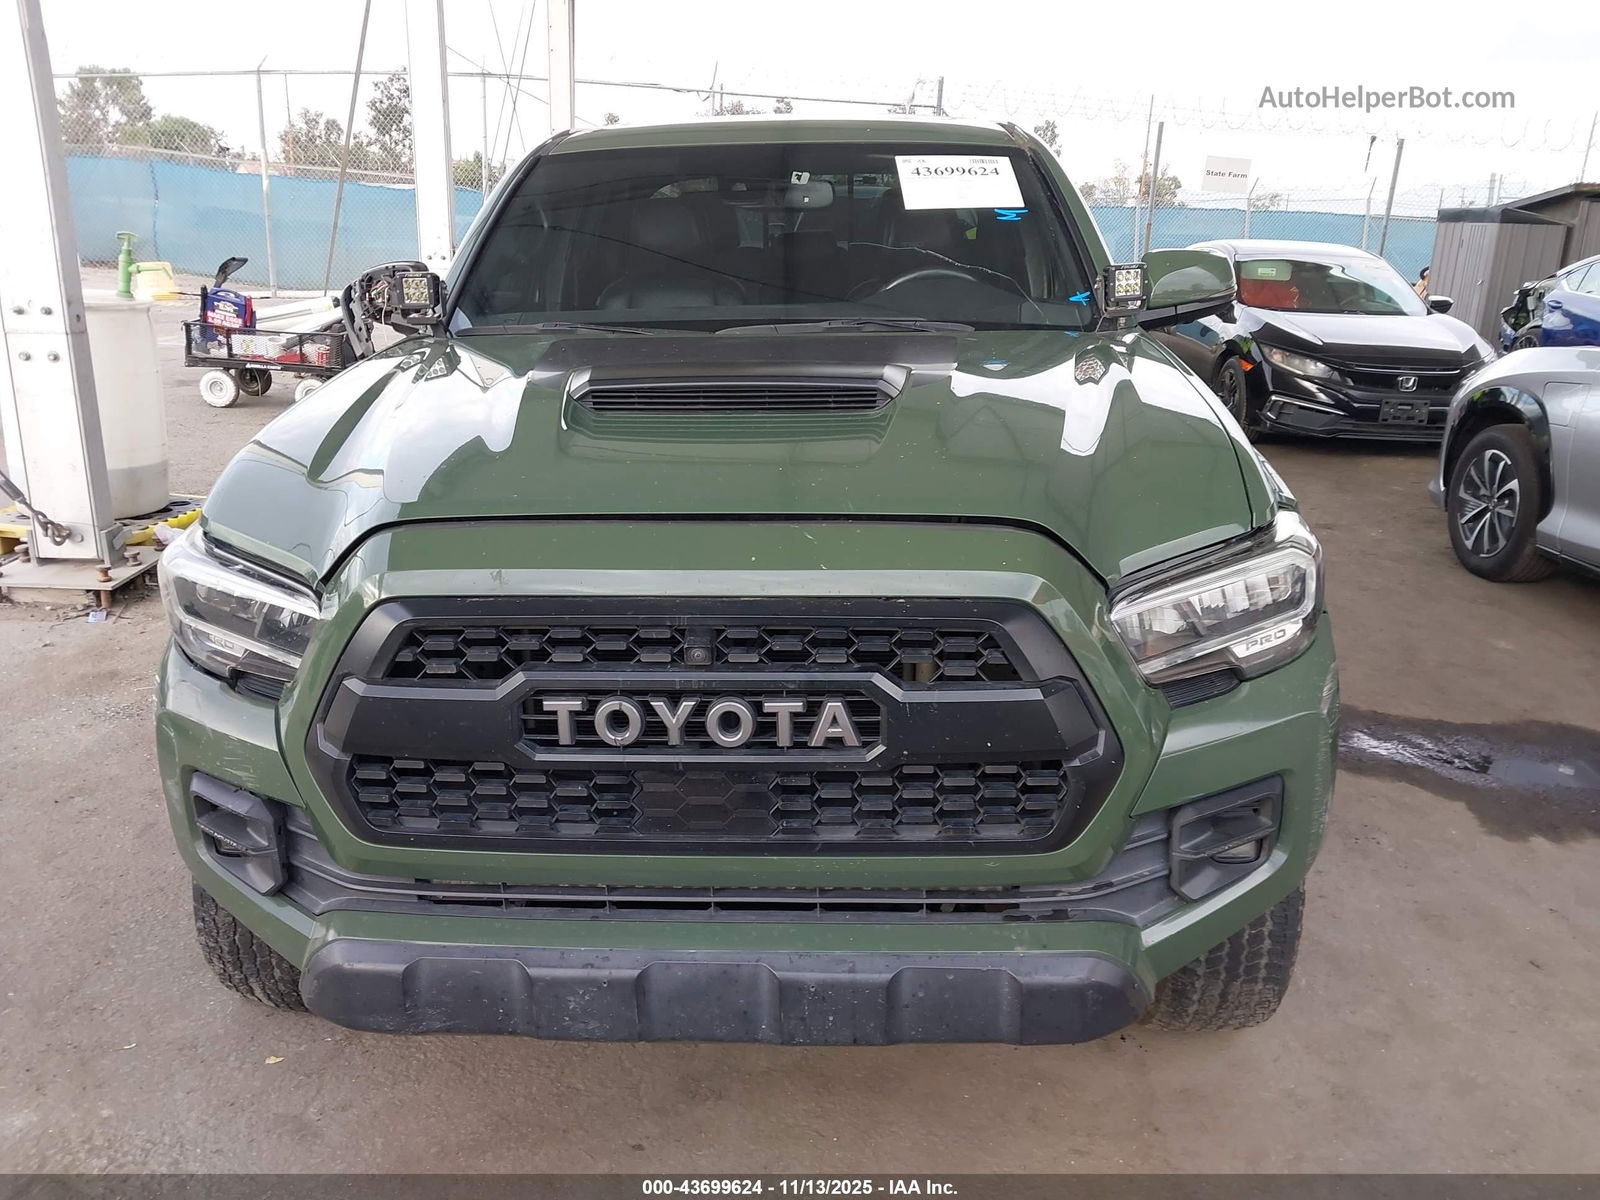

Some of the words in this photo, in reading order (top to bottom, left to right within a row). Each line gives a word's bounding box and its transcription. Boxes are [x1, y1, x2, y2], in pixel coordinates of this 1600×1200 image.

[911, 166, 1000, 176] 43699624
[1205, 169, 1226, 177] State
[1228, 171, 1248, 179] Farm
[1246, 629, 1286, 651] PRO
[542, 696, 862, 748] TOYOTA
